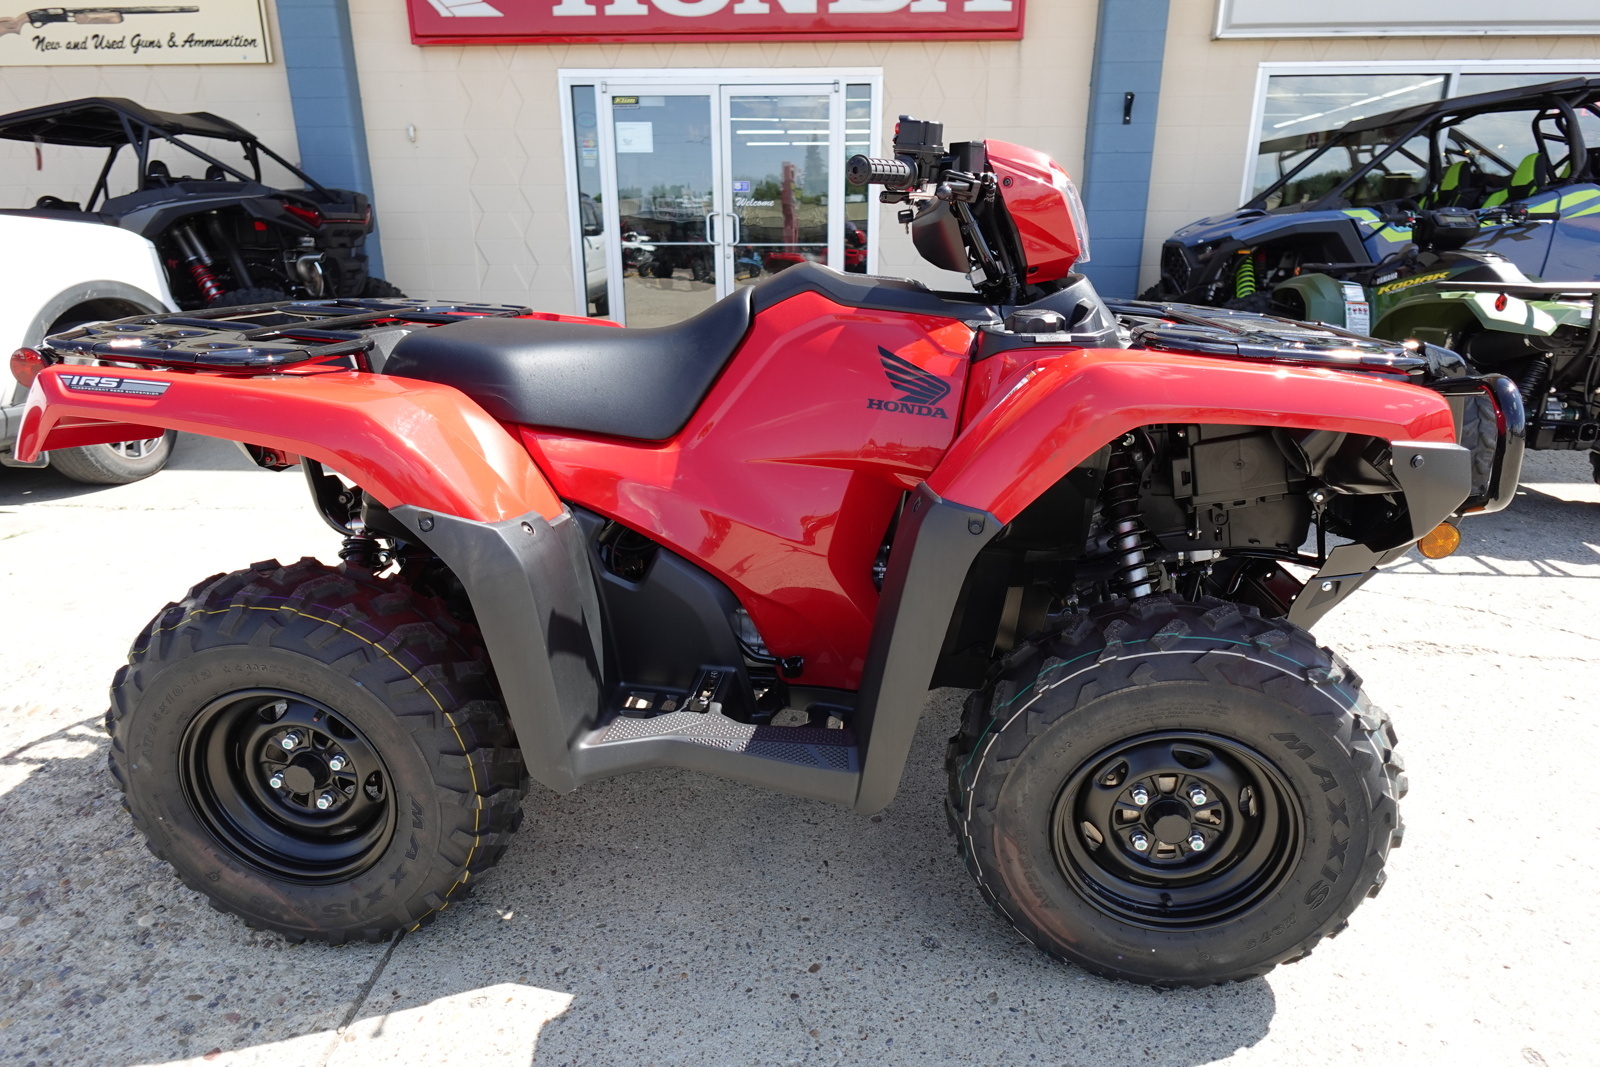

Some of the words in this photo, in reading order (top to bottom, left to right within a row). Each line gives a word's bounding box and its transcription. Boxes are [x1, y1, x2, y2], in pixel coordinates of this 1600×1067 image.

[32, 35, 61, 51] New
[65, 36, 88, 50] and
[91, 34, 126, 50] Used
[130, 33, 162, 54] Guns
[167, 32, 179, 48] &
[181, 33, 258, 48] Ammunition
[735, 197, 775, 207] Welcome
[1378, 271, 1451, 295] KODIAK
[71, 376, 120, 388] IRS
[866, 398, 949, 419] HONDA
[1268, 732, 1350, 911] MAXXIS
[322, 795, 424, 918] MAXXIS
